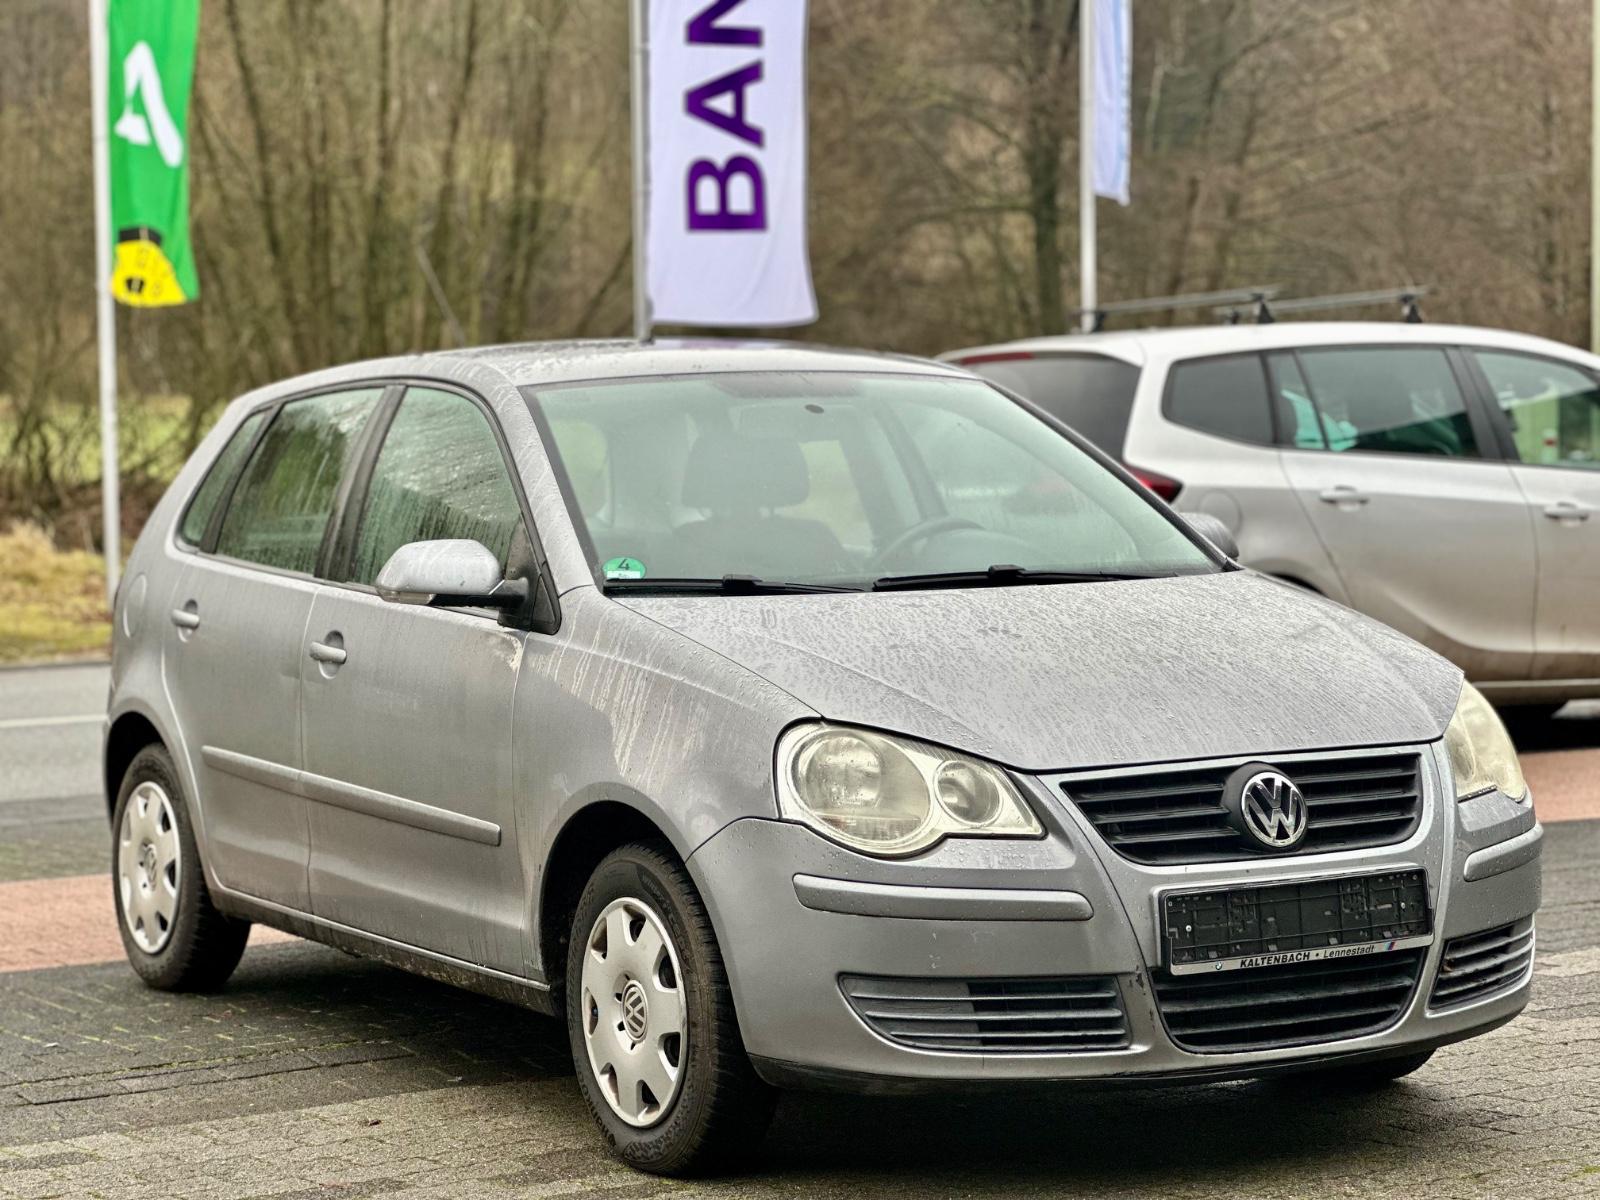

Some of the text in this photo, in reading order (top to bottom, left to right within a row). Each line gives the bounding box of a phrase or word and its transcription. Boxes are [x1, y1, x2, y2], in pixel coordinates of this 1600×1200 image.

[685, 0, 767, 232] BAN
[617, 558, 630, 571] 4
[1241, 772, 1307, 848] VW
[1239, 945, 1375, 968] KALTENBACH Lennestadt
